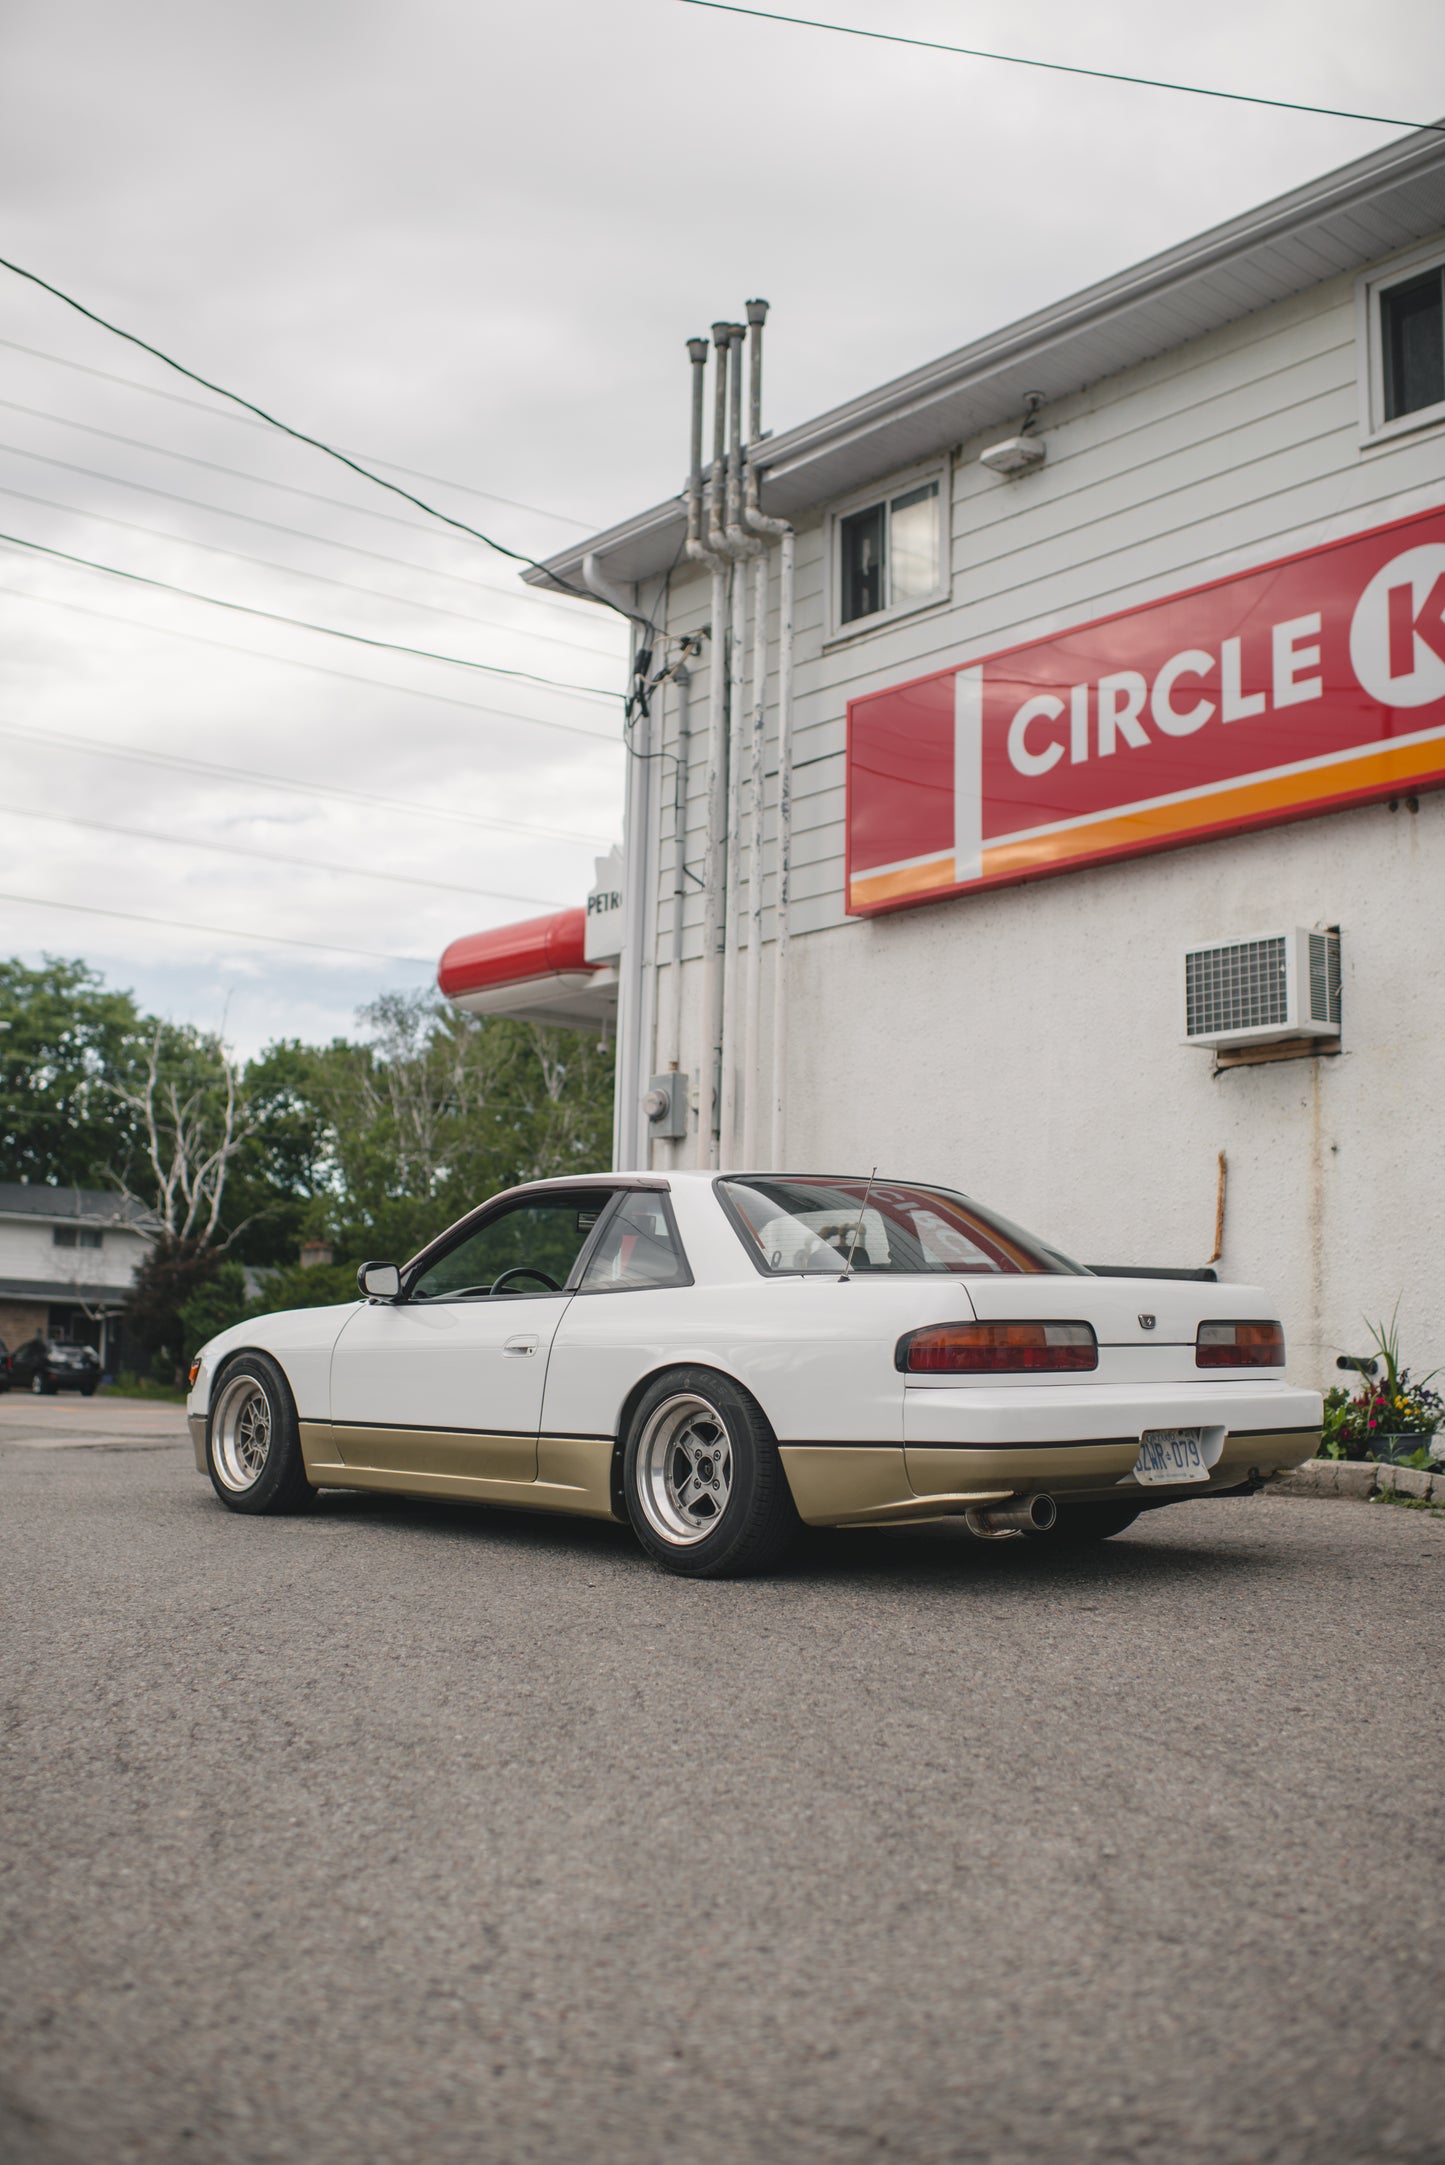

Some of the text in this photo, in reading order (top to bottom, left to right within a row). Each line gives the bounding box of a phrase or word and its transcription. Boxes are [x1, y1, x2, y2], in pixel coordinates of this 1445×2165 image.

[1007, 571, 1445, 776] CIRCLE K
[587, 891, 623, 916] PETR
[1170, 1439, 1201, 1468] 079
